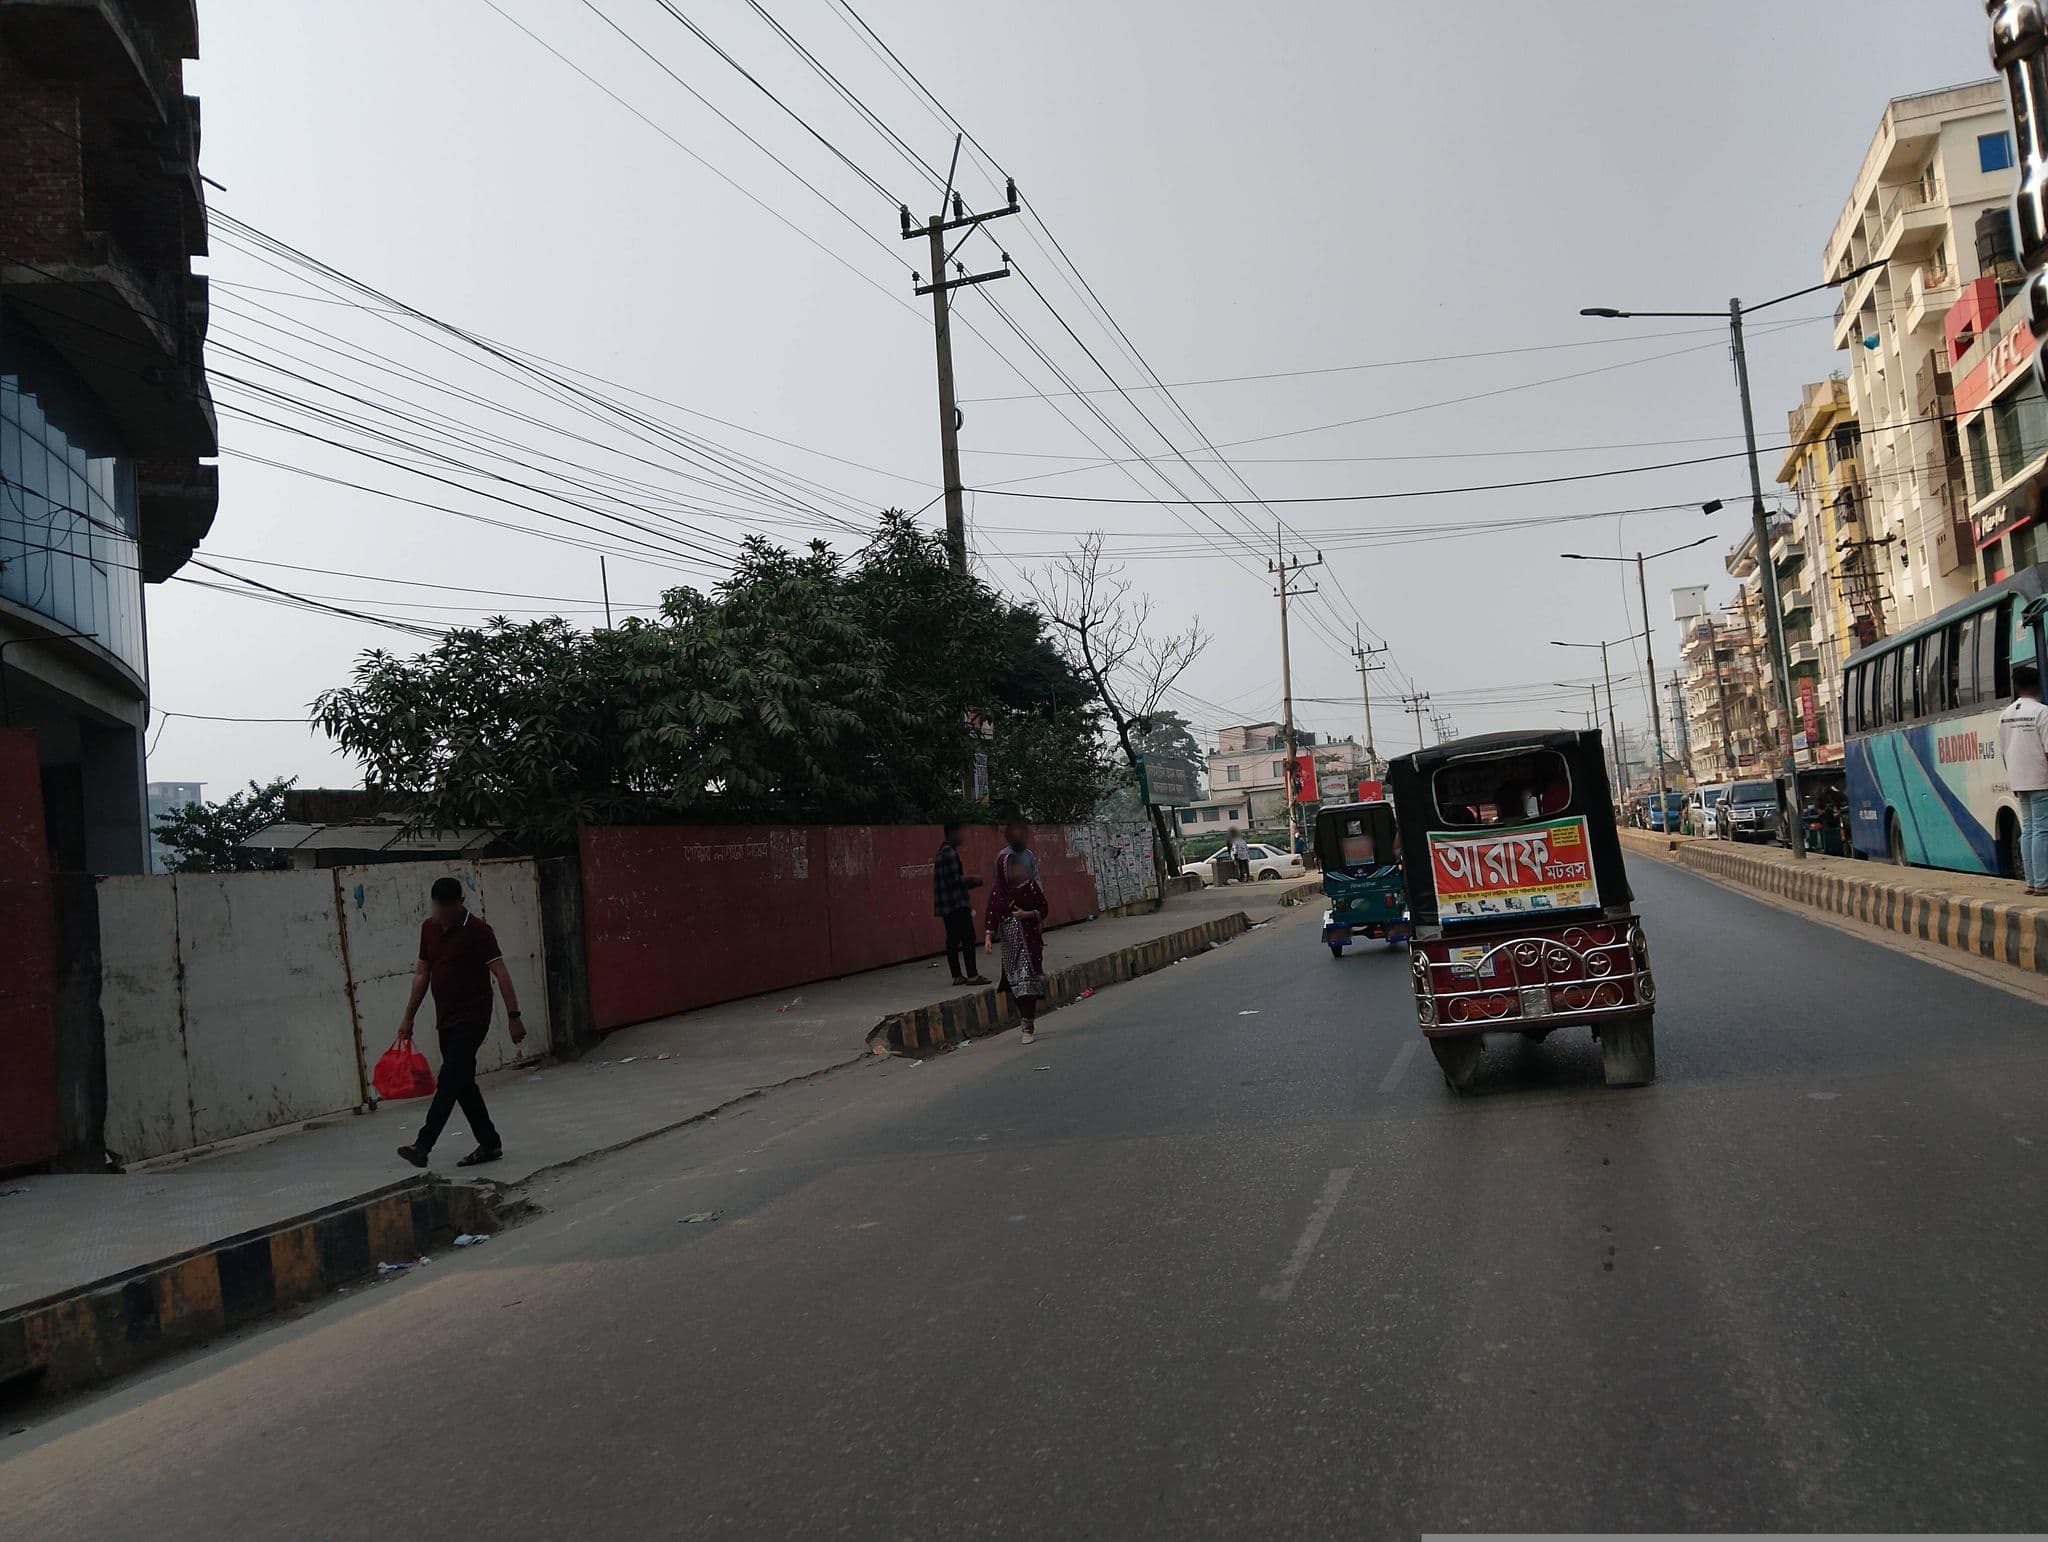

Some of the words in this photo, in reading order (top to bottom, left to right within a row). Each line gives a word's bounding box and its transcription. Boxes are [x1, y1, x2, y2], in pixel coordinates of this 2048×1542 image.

[1986, 323, 2021, 390] KFC
[1938, 732, 1979, 764] BADHON
[1978, 741, 1995, 760] PLUS
[1435, 832, 1549, 888] আরাফ
